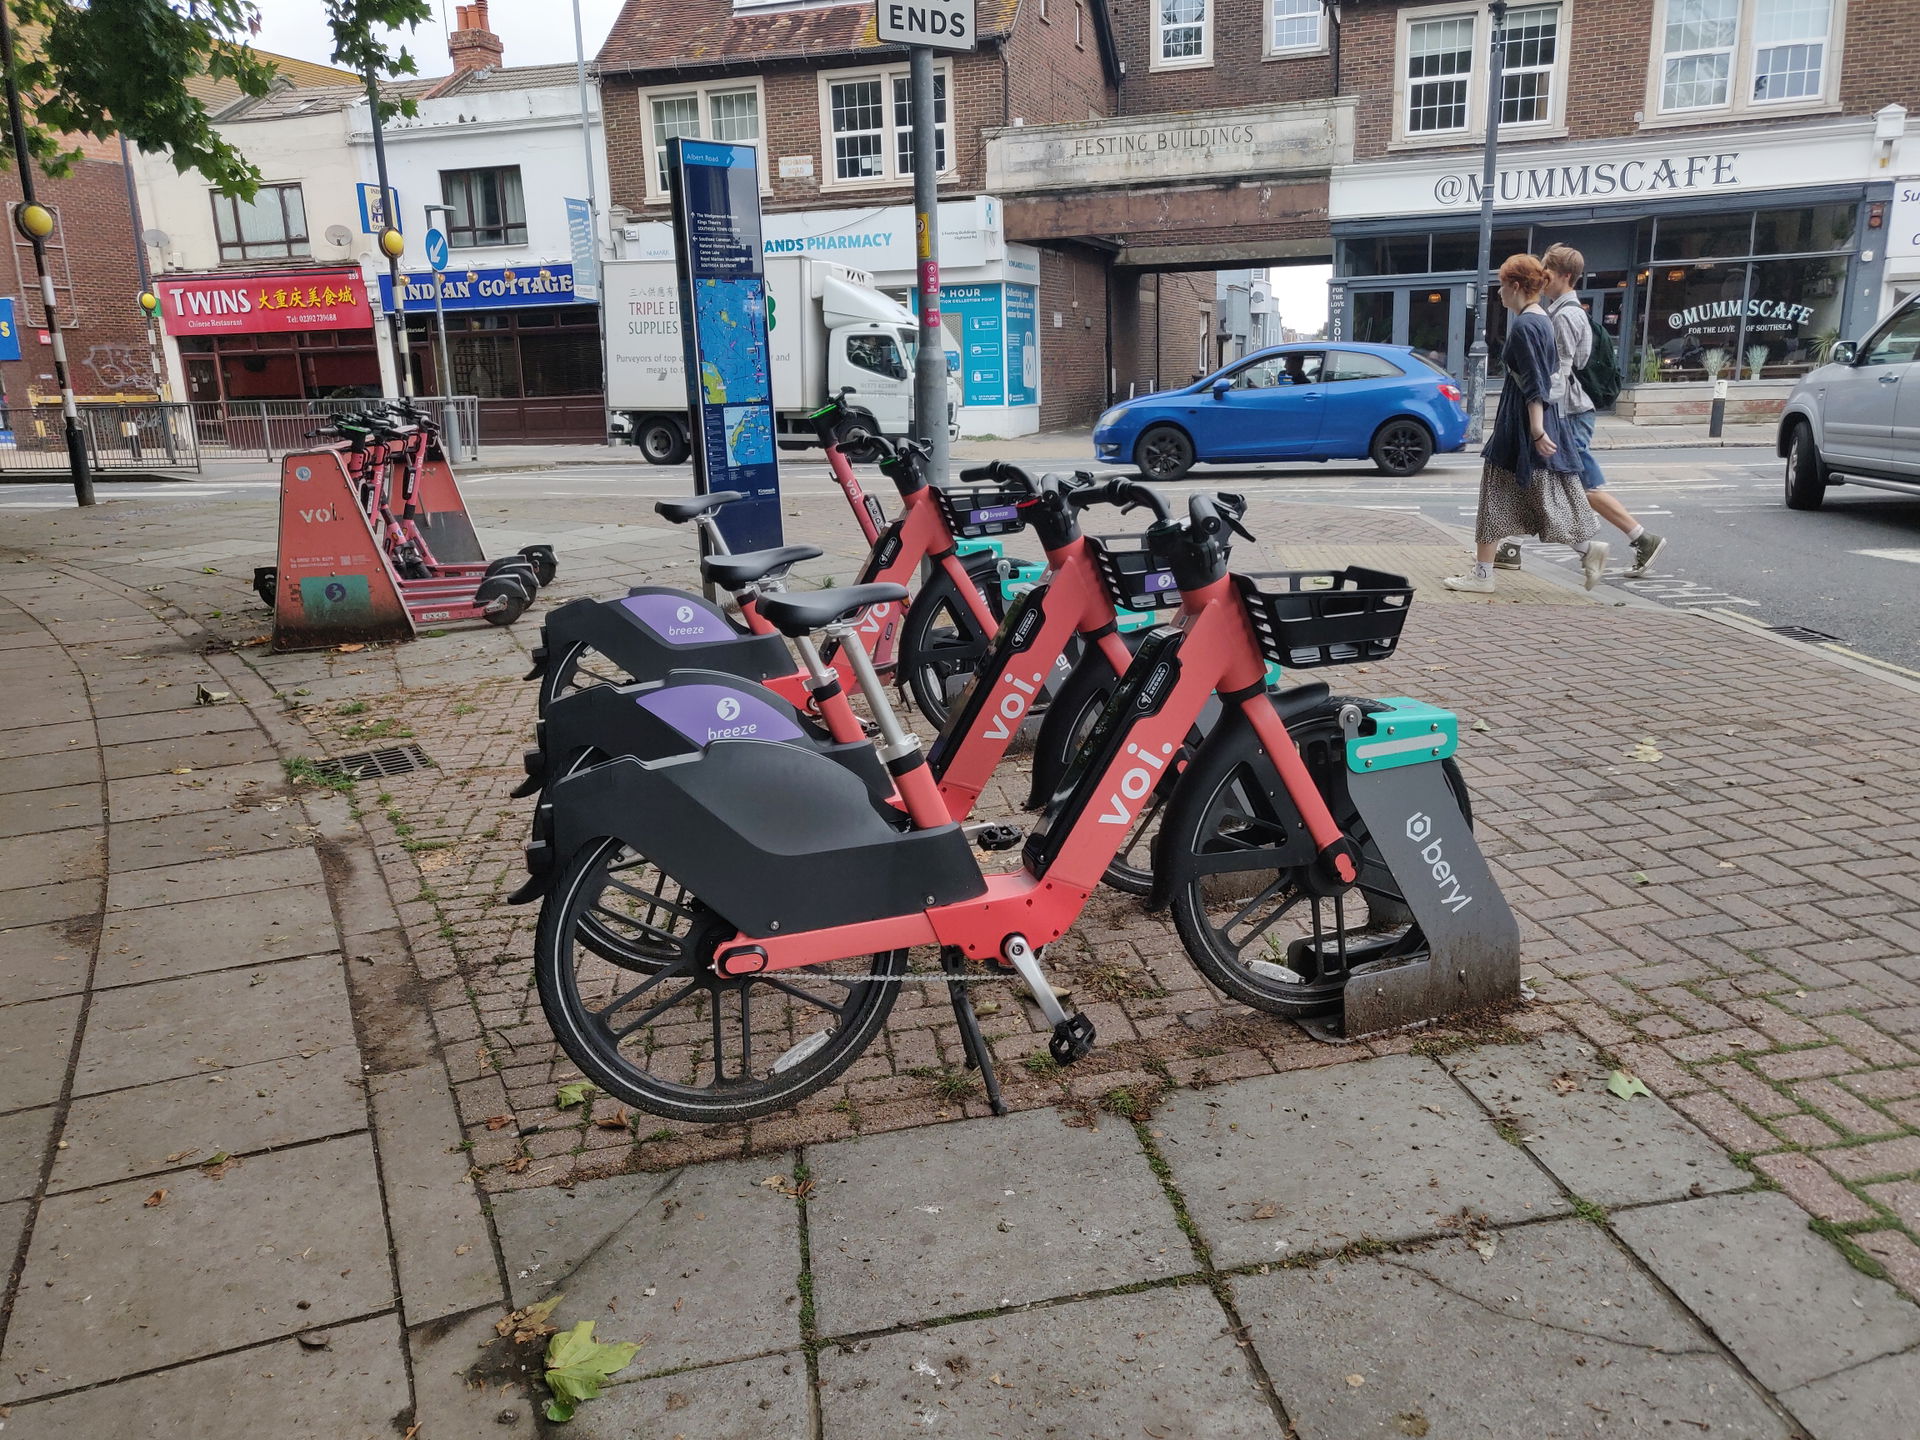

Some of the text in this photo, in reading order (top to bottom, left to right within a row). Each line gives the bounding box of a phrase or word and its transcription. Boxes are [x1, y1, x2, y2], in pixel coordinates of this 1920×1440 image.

[890, 4, 965, 38] ENDS
[1074, 125, 1254, 157] FESTING BUILDINGS
[686, 153, 719, 162] Albert Road
[1434, 152, 1740, 205] @MUMMSCAFE
[1901, 189, 1920, 204] Su
[764, 232, 893, 253] ANDS PHARMACY
[479, 274, 573, 297] COTTAGE
[950, 288, 981, 298] HOUR
[169, 288, 251, 316] TWINS
[629, 301, 665, 315] TRIPLE
[287, 315, 299, 323] Tel:
[1668, 299, 1815, 330] @MUMMSCAFE
[0, 321, 10, 337] S
[188, 319, 242, 328] Chinese Restaurant
[628, 320, 678, 335] SUPPLIES
[1703, 326, 1716, 334] THE
[1718, 325, 1735, 333] LOVE
[1756, 323, 1792, 332] SOUTHSEA
[616, 354, 652, 363] Purveyors
[654, 354, 661, 362] of
[664, 355, 677, 363] top
[776, 353, 790, 361] and
[990, 511, 1008, 519] breeze
[860, 603, 890, 633] vo
[668, 626, 705, 636] breeze
[1149, 667, 1167, 696] SEGWAY
[982, 672, 1042, 740] voi.
[707, 723, 757, 740] breeze
[1097, 742, 1173, 825] voi.
[1420, 838, 1473, 913] beryl
